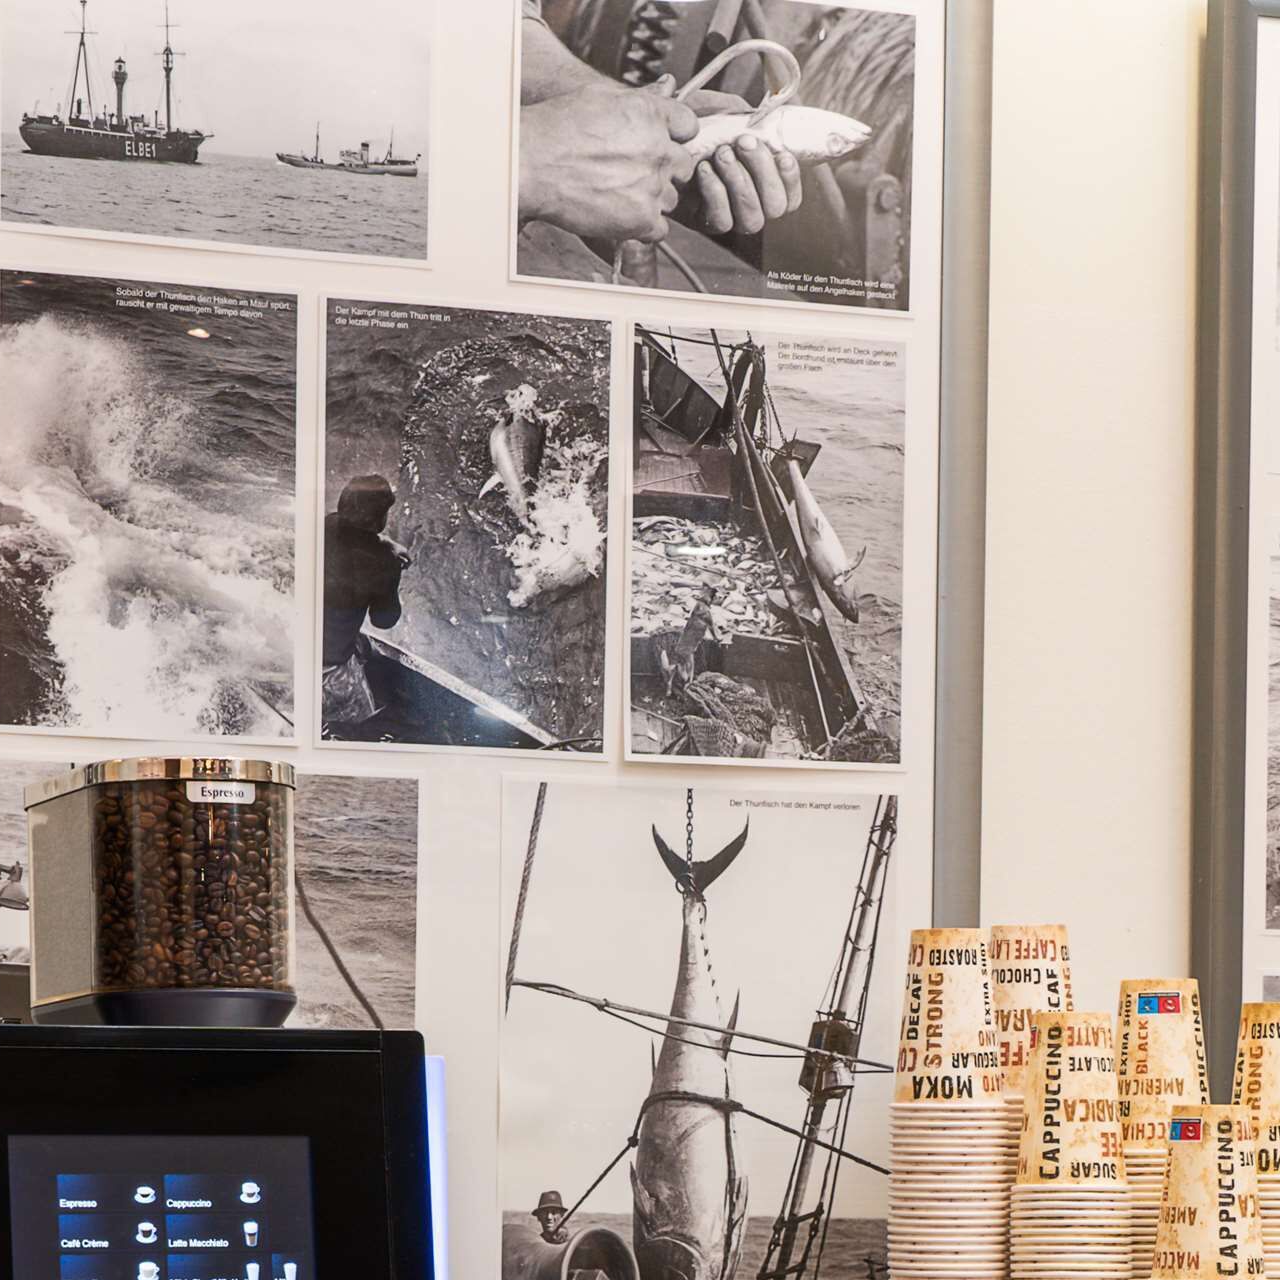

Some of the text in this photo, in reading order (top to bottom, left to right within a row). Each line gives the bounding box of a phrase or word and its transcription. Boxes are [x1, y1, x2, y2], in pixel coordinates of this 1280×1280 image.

[767, 270, 779, 280] Als
[814, 274, 828, 283] den
[829, 276, 863, 287] Thunfisch
[864, 280, 879, 289] wird
[809, 285, 823, 293] den
[116, 287, 143, 298] Sobald
[144, 290, 157, 298] der
[159, 290, 196, 302] Thunfisch
[197, 294, 212, 304] den
[213, 295, 238, 306] Haken
[249, 298, 268, 309] Maul
[116, 299, 145, 309] rauscht
[156, 302, 168, 310] mit
[169, 303, 212, 315] gewaltigem
[213, 307, 238, 318] Tempo
[336, 306, 349, 315] Der
[391, 310, 408, 319] dem
[409, 311, 428, 320] Thun
[371, 319, 395, 328] Phase
[201, 786, 244, 799] Espresso
[929, 948, 978, 967] ROASTED
[906, 972, 923, 1041] DECAF
[923, 971, 945, 1069] STRONG
[1135, 1019, 1149, 1075] BLACK
[912, 1075, 973, 1100] MOKA
[1039, 1025, 1064, 1180] CAPPUCCINO
[1070, 1161, 1118, 1181] SUGAR
[59, 1198, 97, 1209] Espresso
[166, 1199, 212, 1209] Cappuccino
[1216, 1119, 1239, 1277] CAPPUCCINO
[60, 1239, 81, 1248] Café
[168, 1239, 229, 1248] Latte Macchiato
